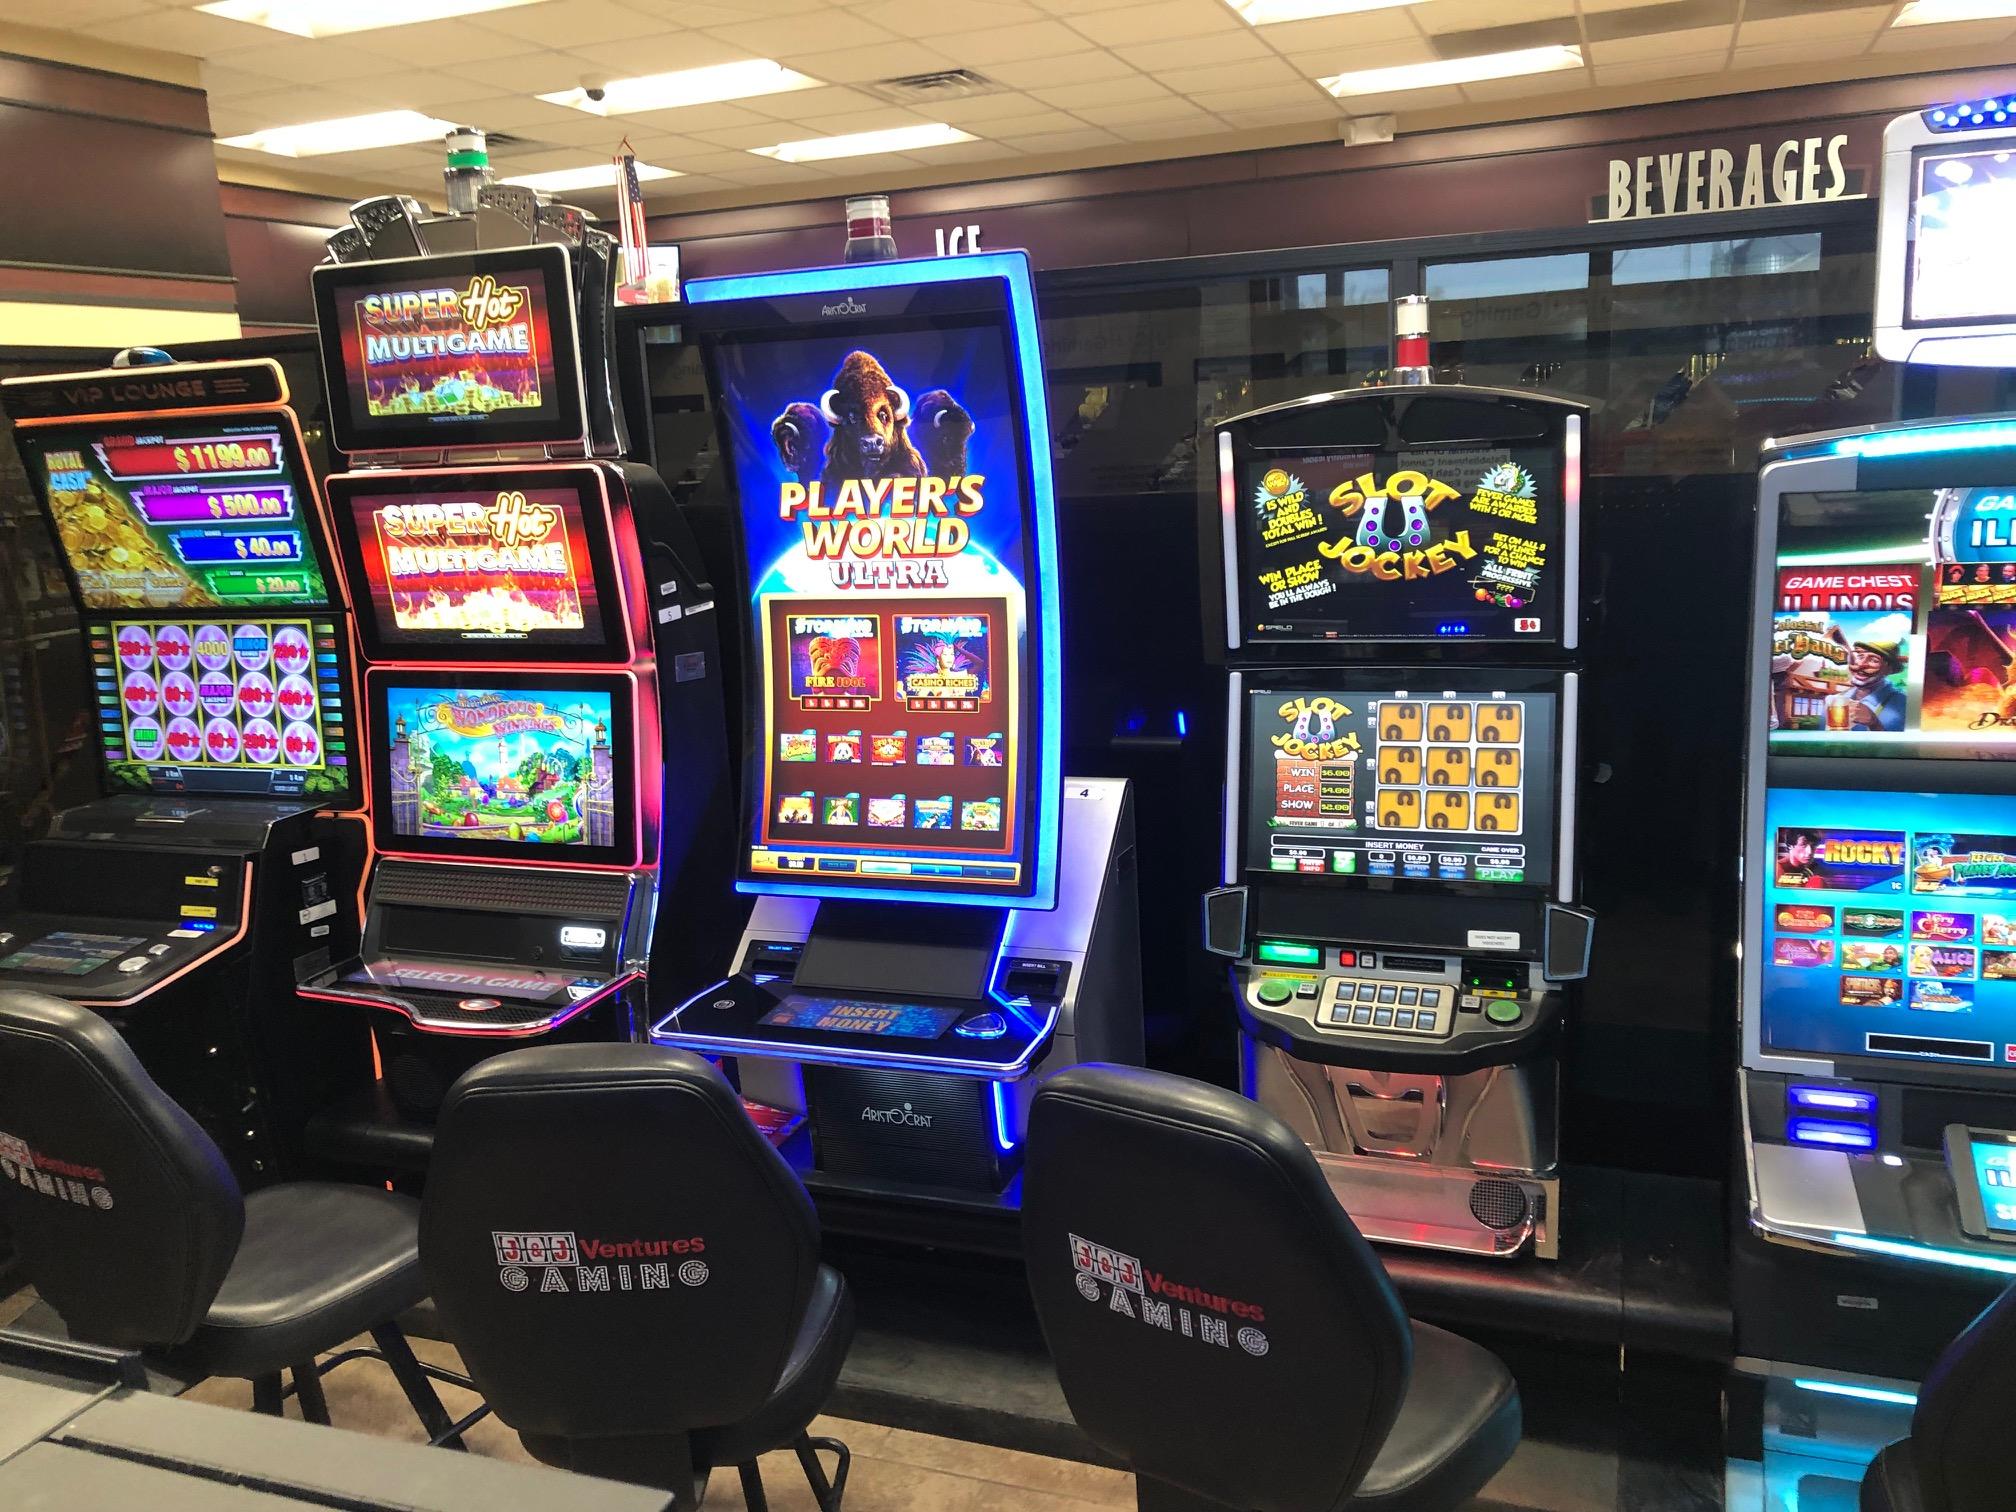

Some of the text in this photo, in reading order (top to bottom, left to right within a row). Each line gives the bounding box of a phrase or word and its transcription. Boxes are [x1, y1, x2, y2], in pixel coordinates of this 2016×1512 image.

[1608, 134, 1848, 219] BEVERAGES
[935, 225, 981, 256] ICE
[363, 277, 522, 329] SUPER Hot
[821, 297, 867, 316] ARISTOCRAT
[366, 324, 530, 363] MULTIGAME
[112, 379, 206, 401] LOUNGE
[780, 475, 985, 520] PLAYER'S
[1266, 492, 1304, 511] IS WILD
[1329, 470, 1462, 517] SLOT
[1476, 488, 1536, 507] FEVER GAMES
[1277, 503, 1300, 518] AND
[1469, 502, 1537, 524] WITH 5 OR MORE
[1472, 496, 1537, 516] ARE AWARDED
[382, 492, 557, 545] SUPER Hot
[1268, 508, 1313, 529] DOUBLES
[802, 517, 970, 560] WORLD
[1262, 525, 1295, 541] TOTAL
[1295, 517, 1316, 531] WIN
[1493, 532, 1509, 542] BET
[1508, 536, 1522, 544] ON
[1522, 540, 1538, 550] ALL
[1496, 541, 1536, 556] PAYLINES
[388, 543, 568, 576] MULTIGAME
[1317, 530, 1478, 581] JOCKEY
[1484, 545, 1501, 555] FOR
[1509, 552, 1546, 566] CHANCE
[1498, 555, 1527, 568] TO WIN
[829, 560, 948, 589] ULTRA
[1270, 569, 1319, 592] OR SHOW
[1481, 570, 1533, 588] PROGRESSIVE
[1484, 563, 1534, 580] ALL FRUIT
[1296, 579, 1329, 594] ALWAYS
[1785, 575, 1913, 589] GAME CHEST
[1268, 601, 1279, 609] BE
[1280, 598, 1288, 606] IN
[1289, 594, 1303, 603] THE
[1304, 586, 1331, 599] DOUGH
[1783, 594, 1913, 611] ILLINOIS
[200, 685, 233, 697] MAJOR
[805, 677, 835, 687] FIRE
[913, 679, 975, 687] CASINO RICHES
[1278, 697, 1353, 722] SLOT
[1270, 732, 1361, 761] JOCKEY
[1290, 768, 1315, 777] WIN
[1080, 789, 1089, 797] 4
[1283, 784, 1314, 793] PLACE
[1281, 800, 1313, 809] SHOW
[1365, 841, 1424, 850] INSERT MONEY
[1824, 839, 1904, 865] ROCKY
[1481, 869, 1516, 879] PLAY
[1917, 917, 1968, 937] Cherry
[1932, 951, 1973, 965] ALICE
[389, 968, 560, 993] SELECT A GAME
[830, 1005, 902, 1020] INSERT
[816, 1016, 892, 1033] MONEY
[862, 1102, 932, 1128] ARISTOCRAT
[502, 1237, 706, 1262] J&J Ventures
[1078, 1244, 1265, 1322] J&J Ventures
